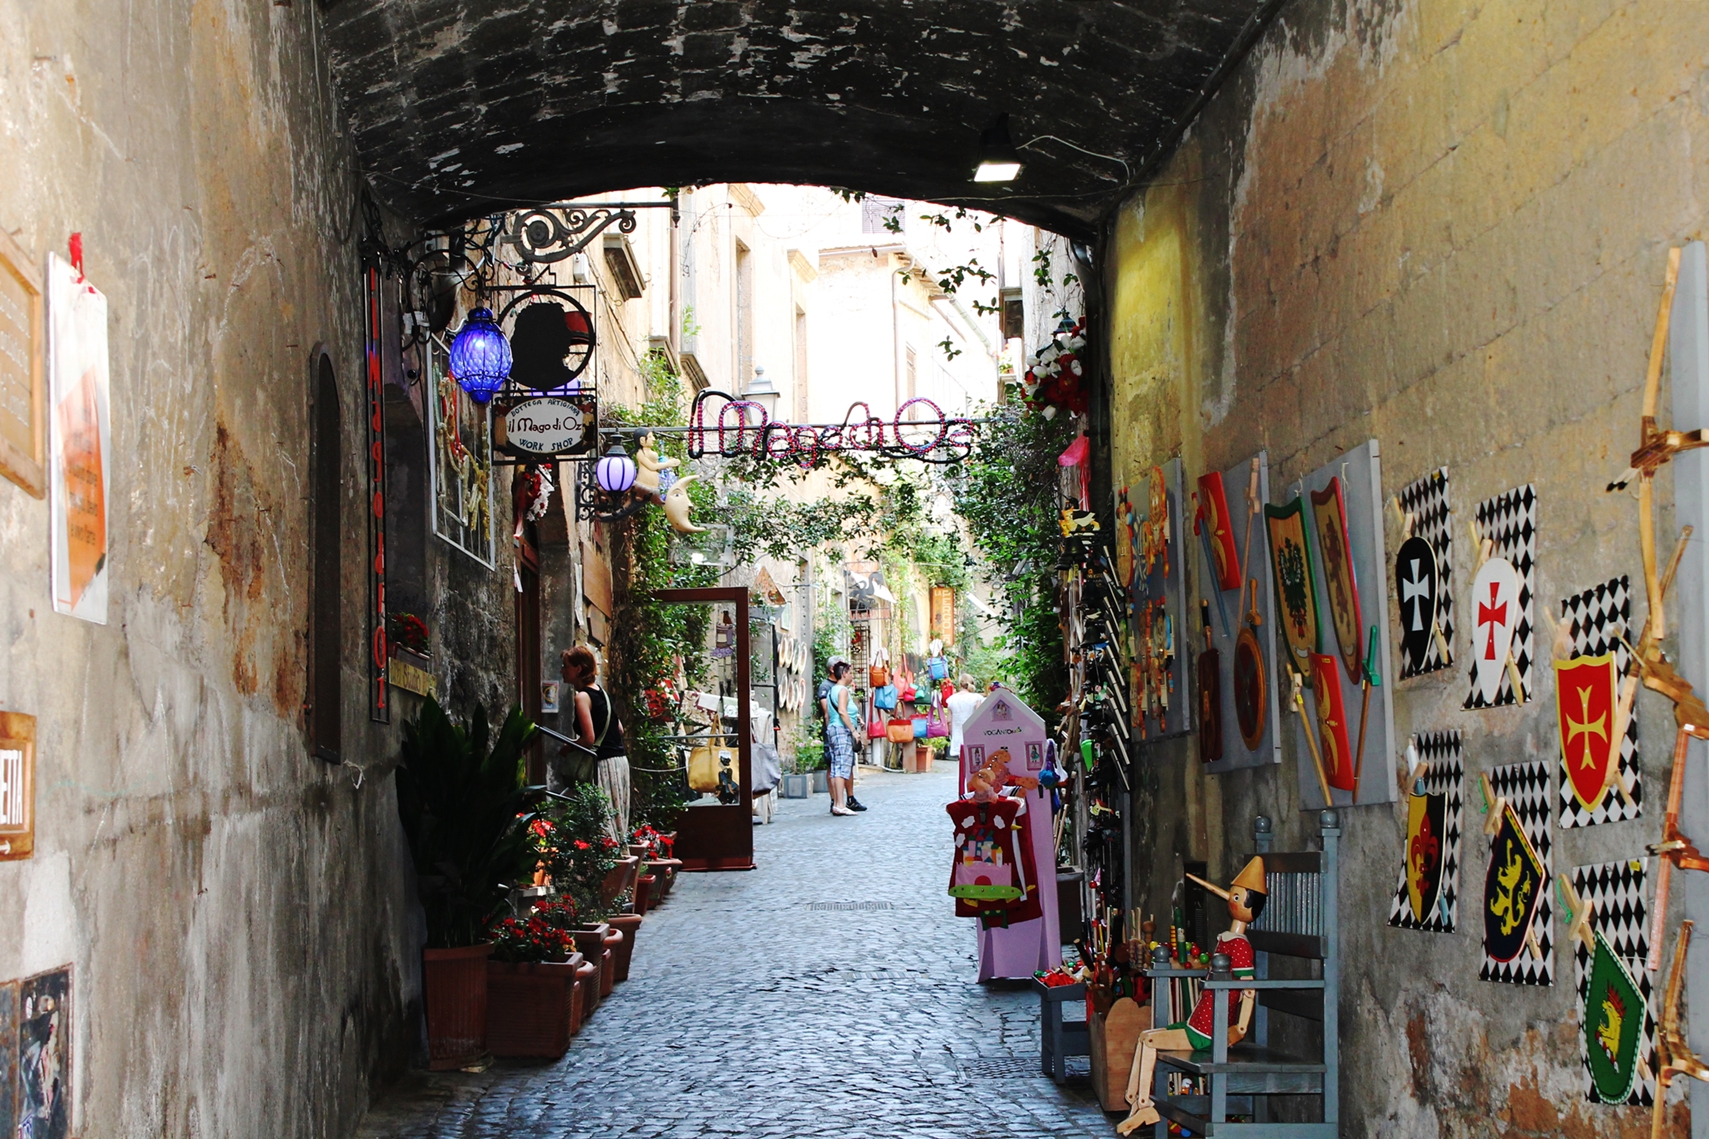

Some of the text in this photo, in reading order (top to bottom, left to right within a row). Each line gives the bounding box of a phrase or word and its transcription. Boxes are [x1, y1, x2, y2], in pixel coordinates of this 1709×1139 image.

[511, 398, 580, 417] BOTTEGA ARTIGIANA
[508, 416, 582, 433] il Mago di Oz
[369, 350, 383, 520] Mago
[519, 437, 573, 451] WORK SHOP
